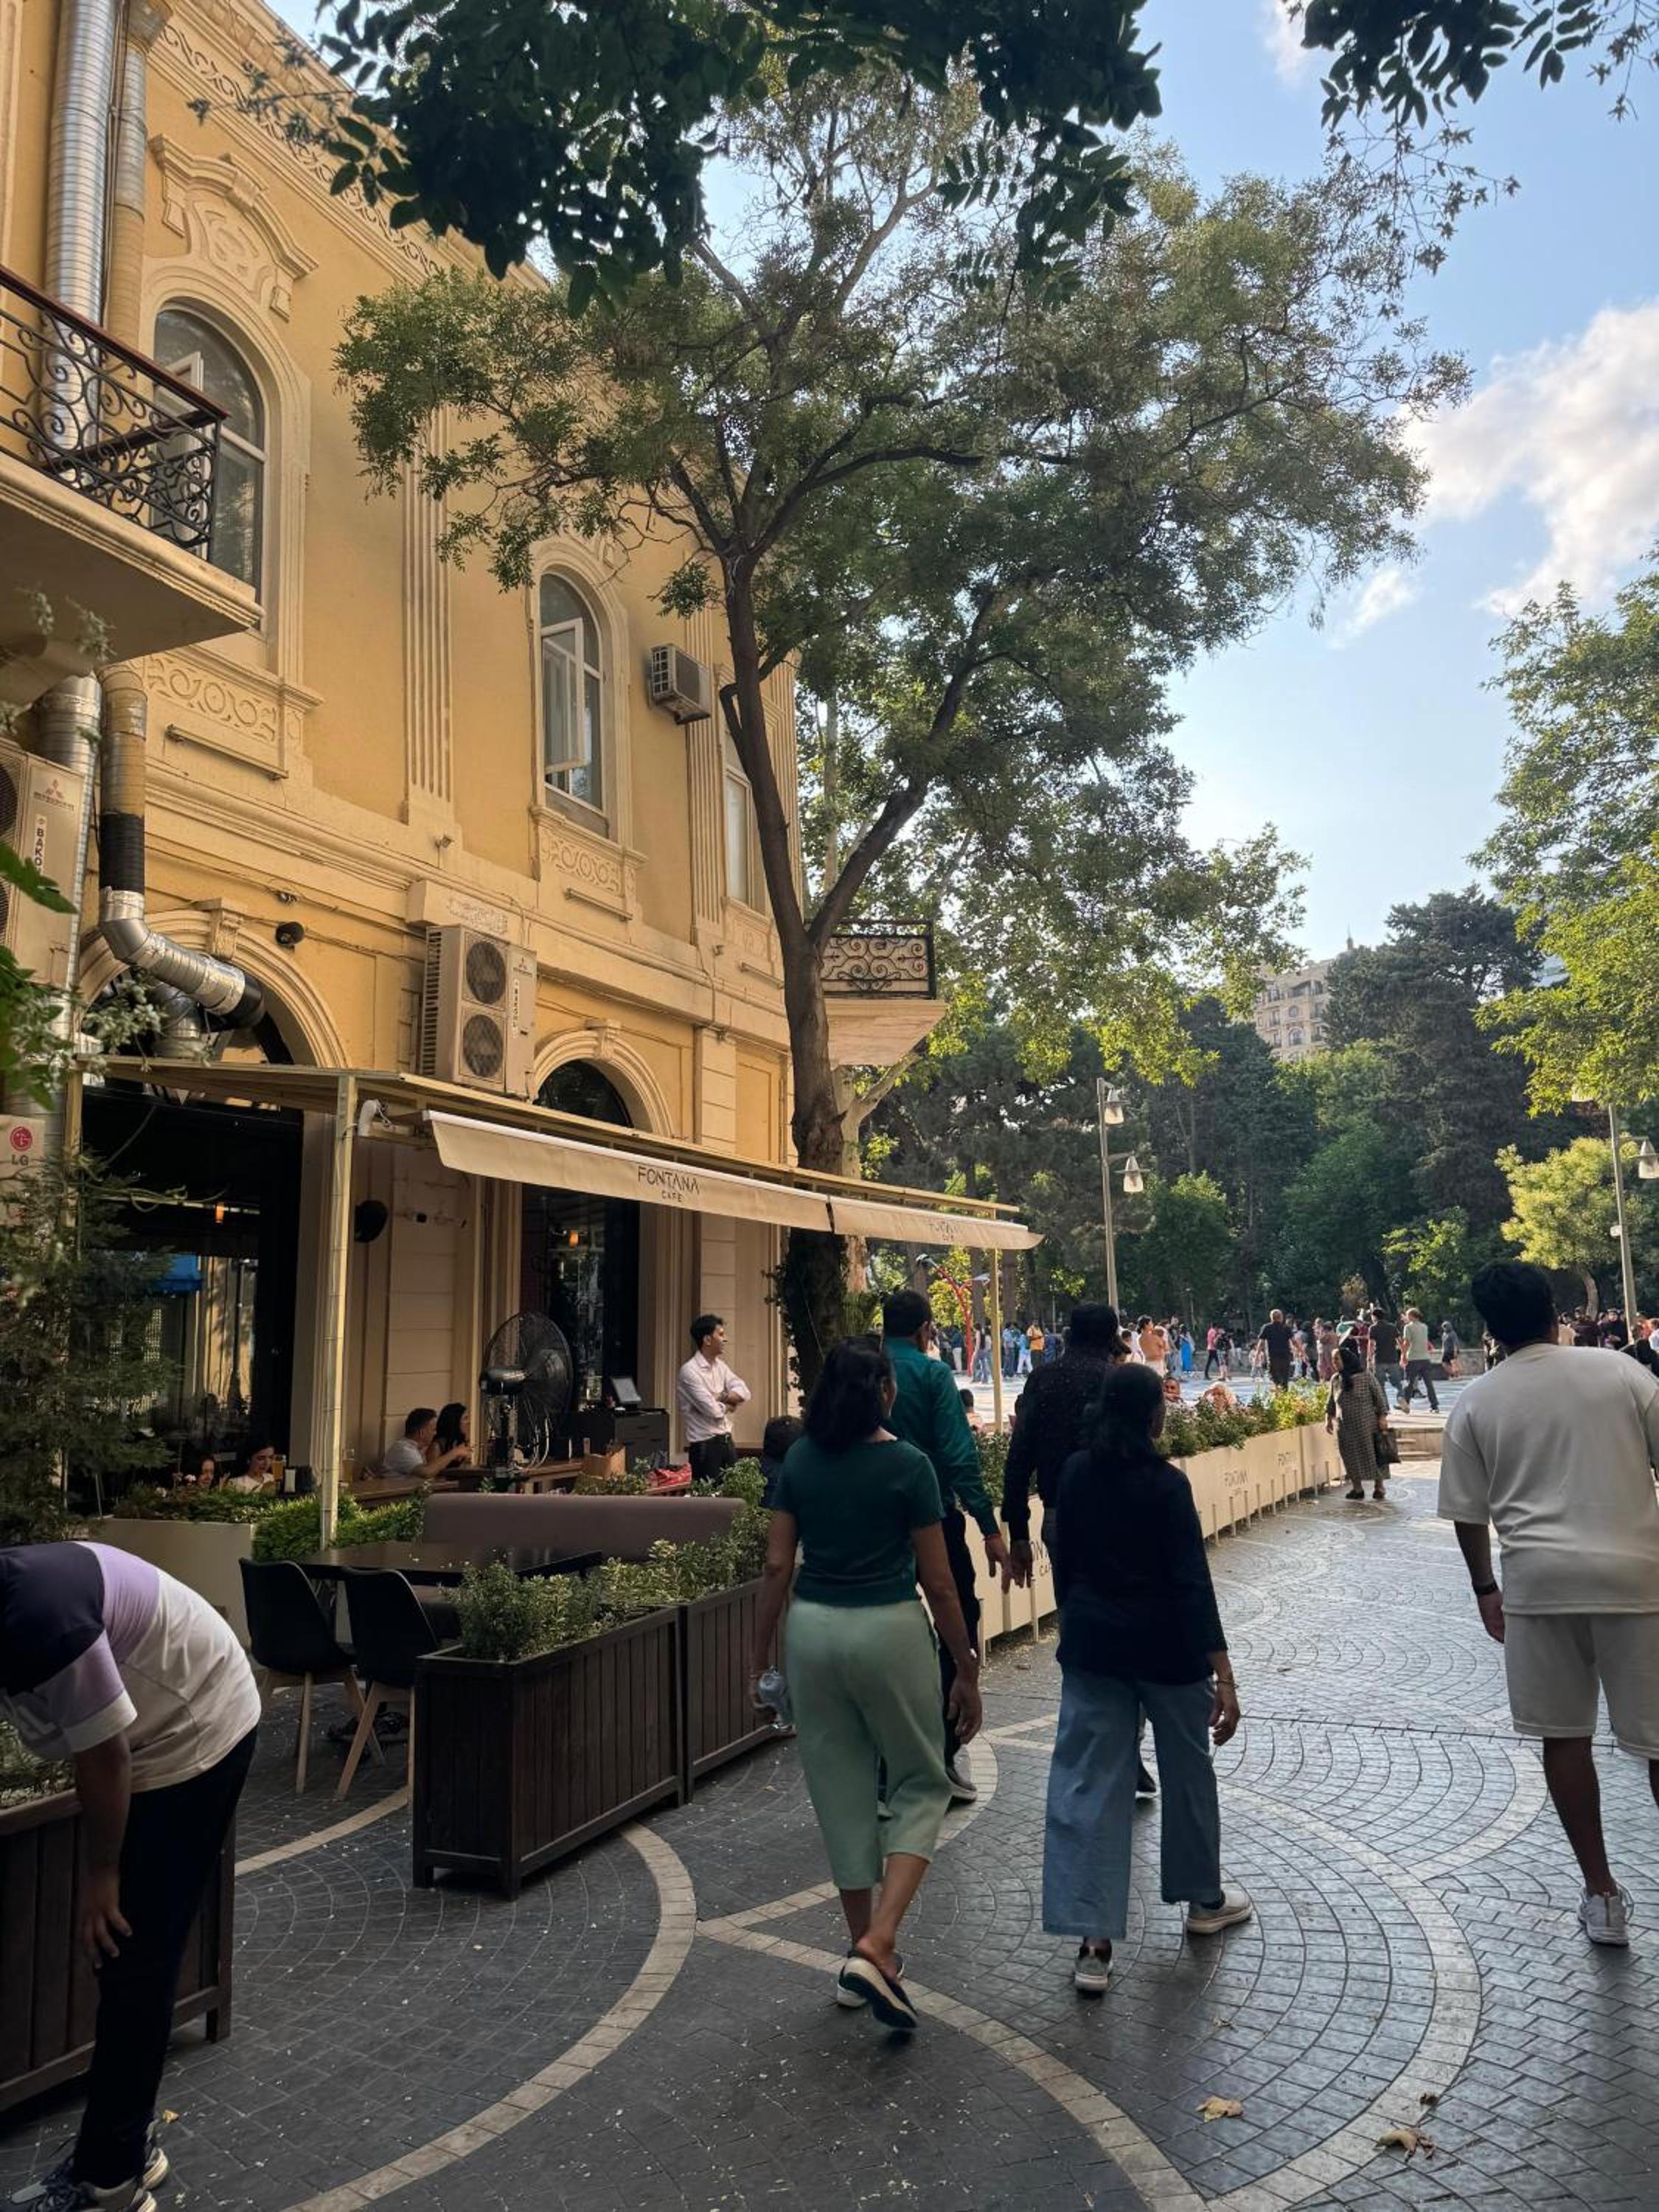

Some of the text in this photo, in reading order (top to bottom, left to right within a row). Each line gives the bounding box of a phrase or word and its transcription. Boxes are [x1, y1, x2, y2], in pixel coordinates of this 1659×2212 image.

[11, 1154, 29, 1166] LG
[638, 1166, 700, 1194] FONTANA
[661, 1190, 683, 1203] CAFE
